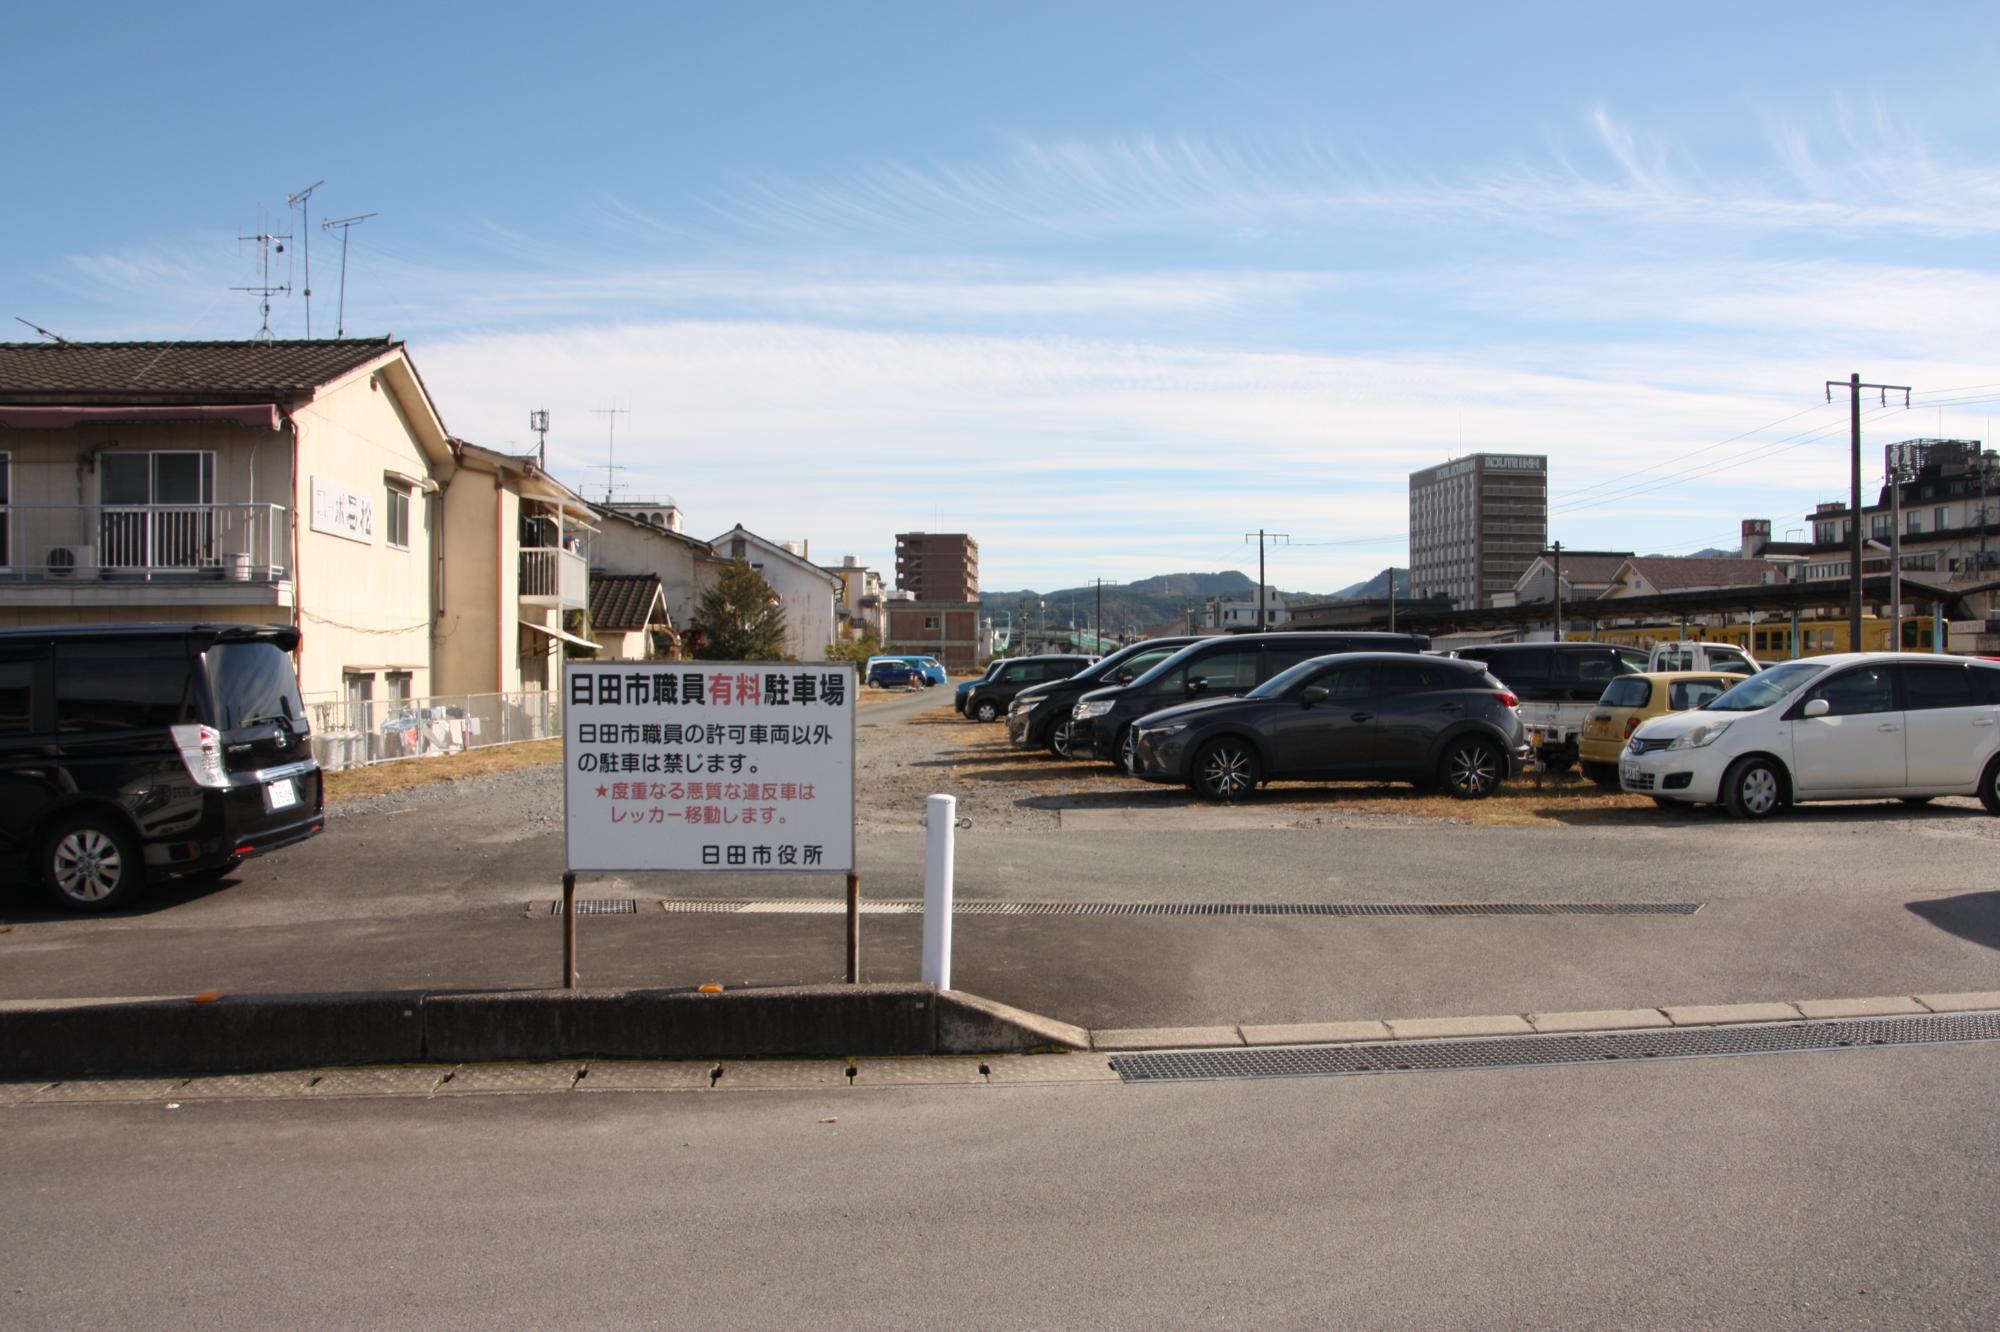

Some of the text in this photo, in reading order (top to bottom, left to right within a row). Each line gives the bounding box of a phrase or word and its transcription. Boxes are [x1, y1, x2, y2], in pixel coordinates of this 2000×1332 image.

[570, 673, 845, 706] 日田市職員有料駐車場
[579, 724, 833, 745] 日田市職員の許可車両以外
[578, 753, 759, 774] の駐車は禁じます。
[611, 806, 787, 825] レッカー移動します。
[702, 845, 823, 865] 日田市役所
